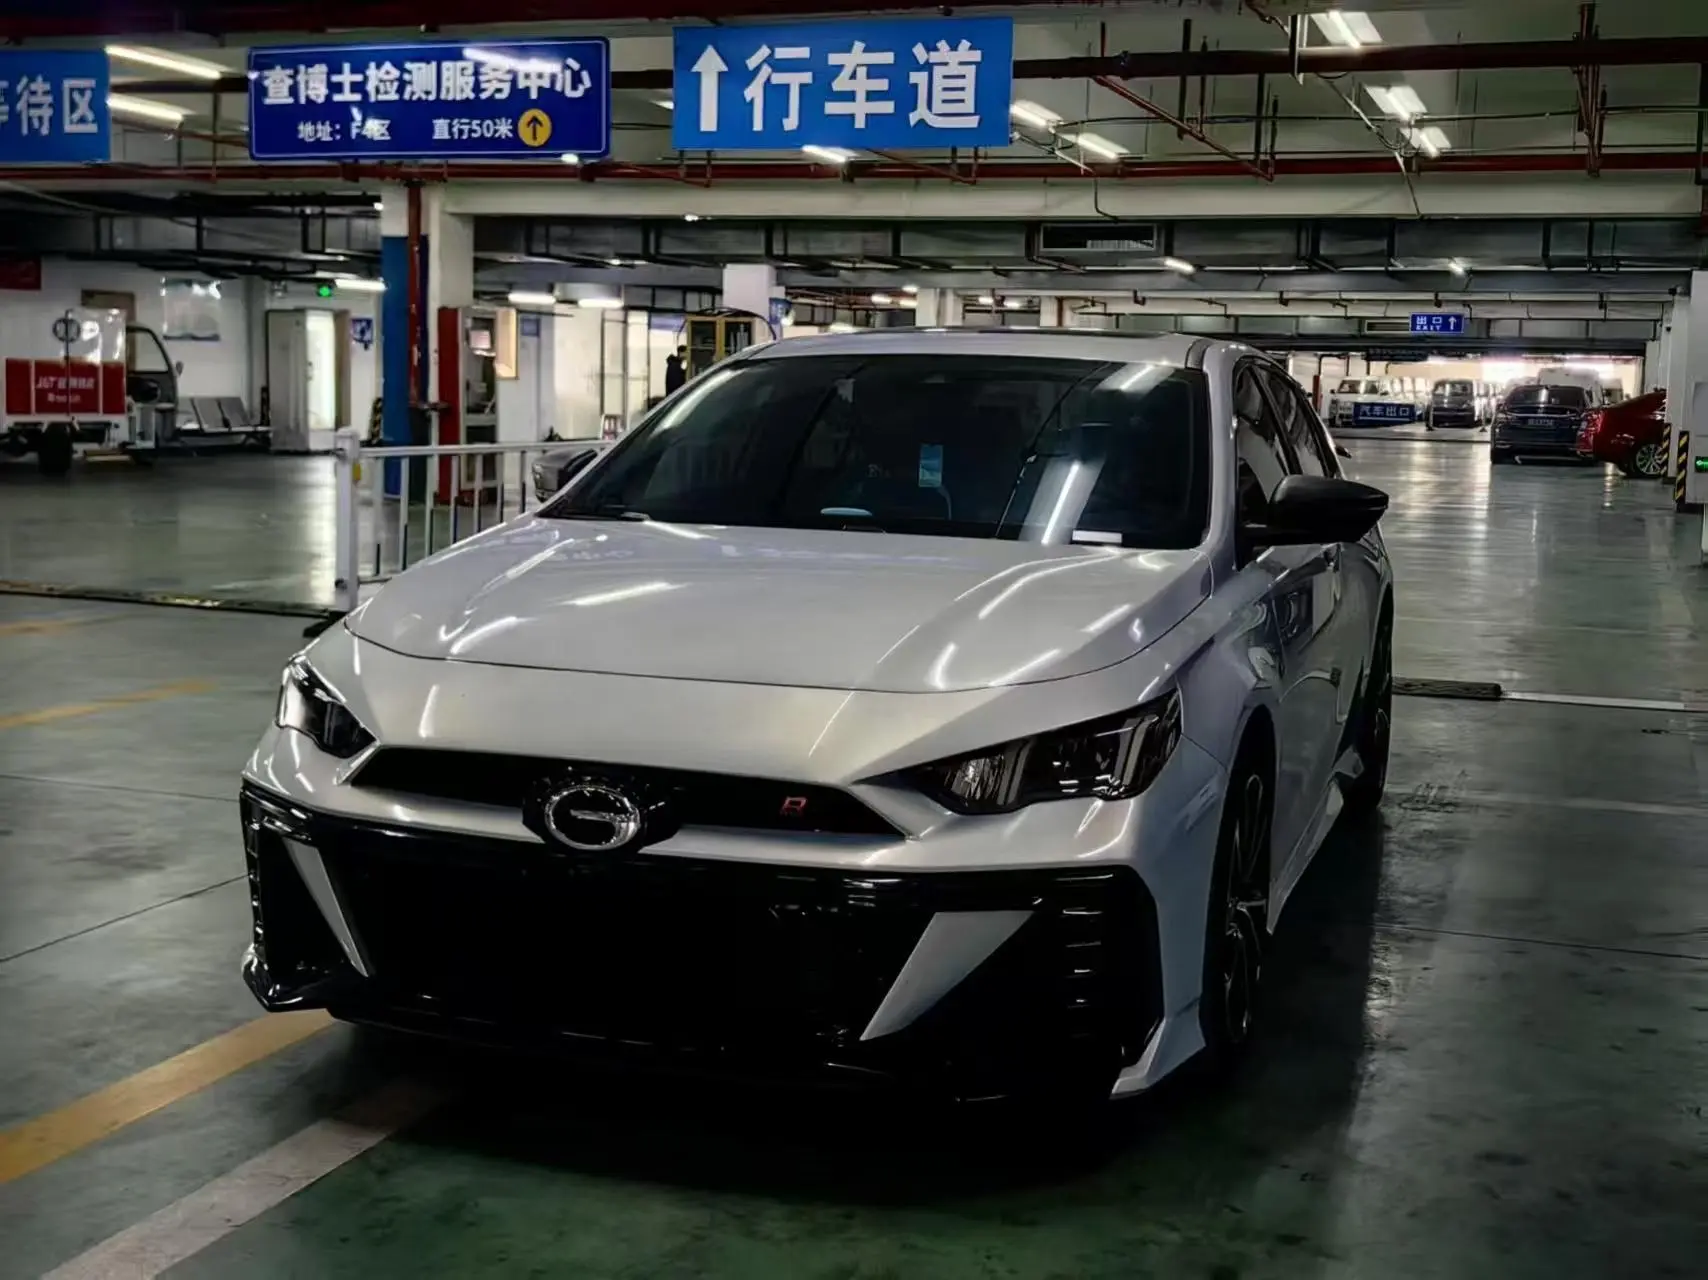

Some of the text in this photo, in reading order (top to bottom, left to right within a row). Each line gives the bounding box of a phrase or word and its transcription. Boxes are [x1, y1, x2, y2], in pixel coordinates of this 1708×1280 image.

[262, 58, 593, 105] 查博士检测服务中心
[744, 39, 982, 131] 行车道
[432, 118, 513, 140] 直行50米
[1416, 316, 1442, 325] 出口
[1360, 405, 1409, 417] 汽车出口
